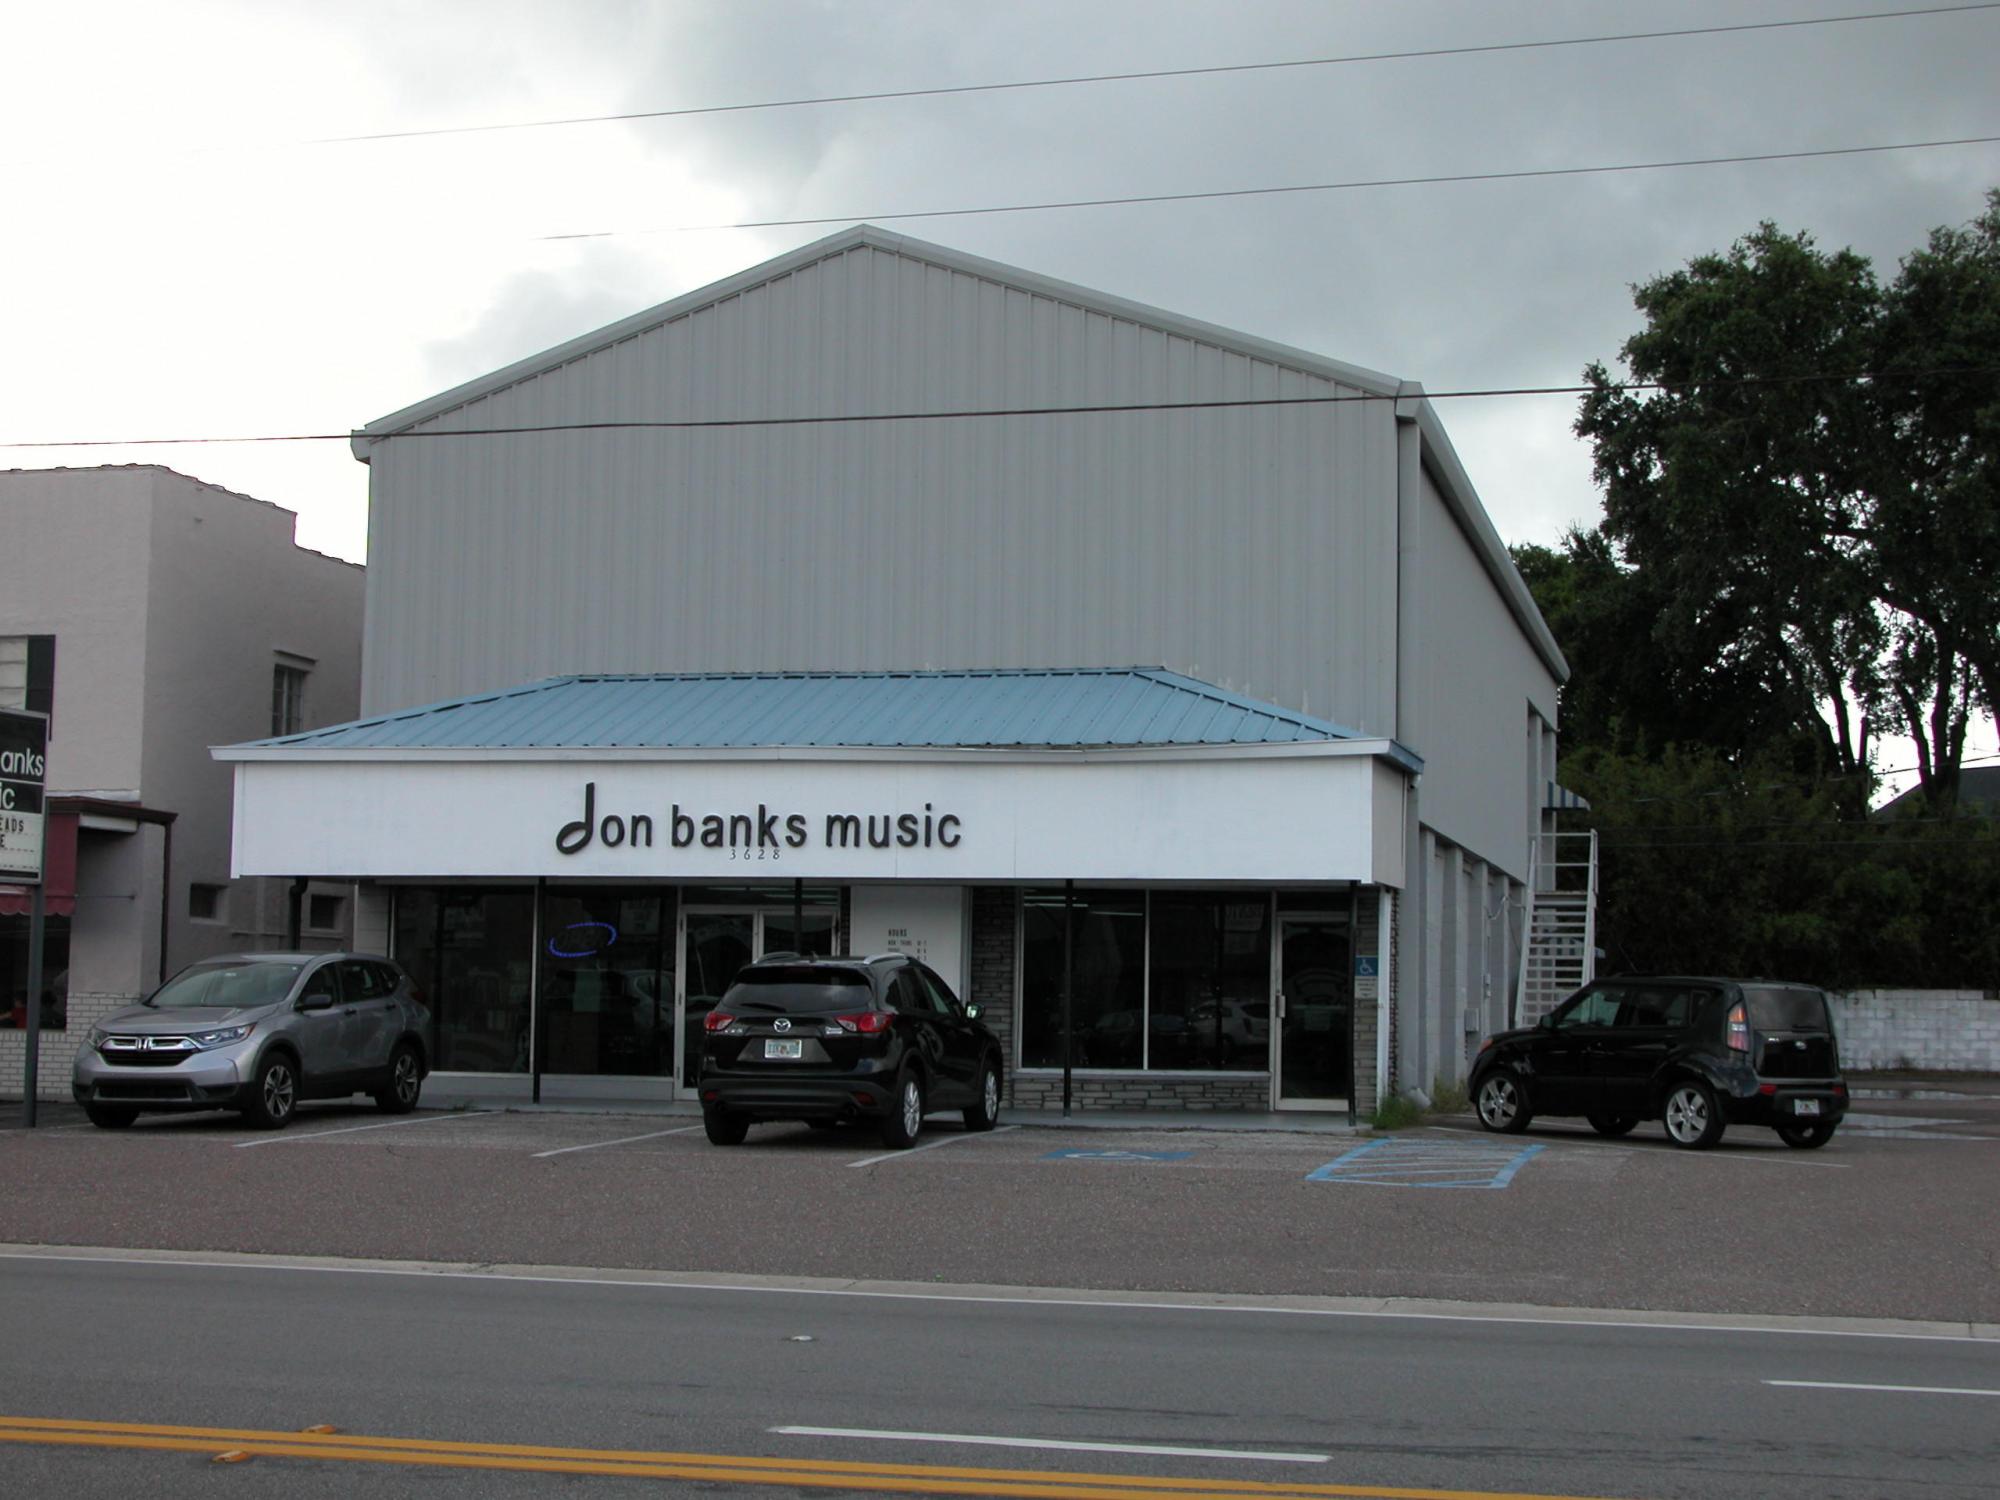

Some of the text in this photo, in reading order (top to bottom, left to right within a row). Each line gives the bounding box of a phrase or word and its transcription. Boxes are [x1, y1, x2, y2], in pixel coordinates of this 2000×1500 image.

[556, 782, 961, 855] don banks music
[730, 849, 780, 860] 3628
